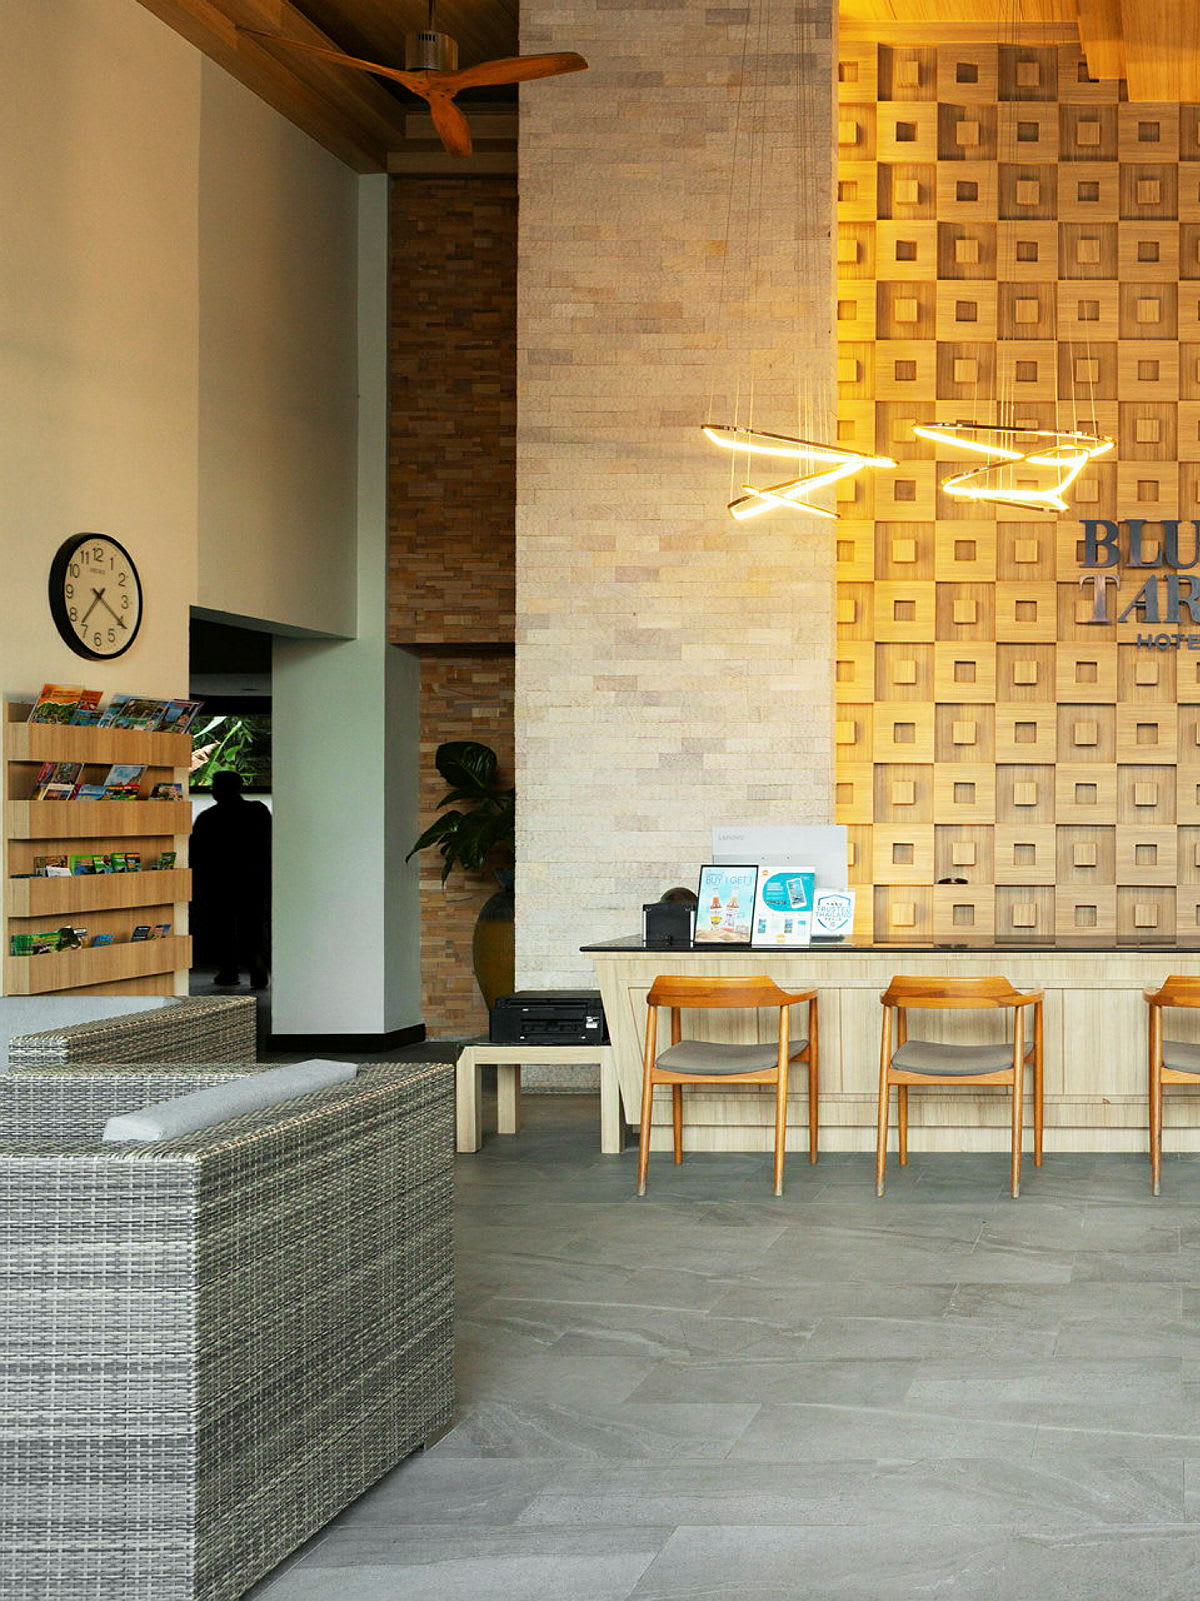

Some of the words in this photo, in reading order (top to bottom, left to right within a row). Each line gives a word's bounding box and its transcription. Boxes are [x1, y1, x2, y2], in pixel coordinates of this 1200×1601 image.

[80, 549, 90, 565] 11
[92, 547, 104, 562] 12
[69, 562, 80, 579] 10
[109, 556, 115, 571] 1
[117, 572, 126, 587] 2
[65, 583, 74, 599] 9
[120, 594, 129, 610] 3
[69, 606, 78, 623] 8
[80, 622, 89, 639] 7
[106, 627, 116, 643] 5
[93, 631, 102, 647] 6
